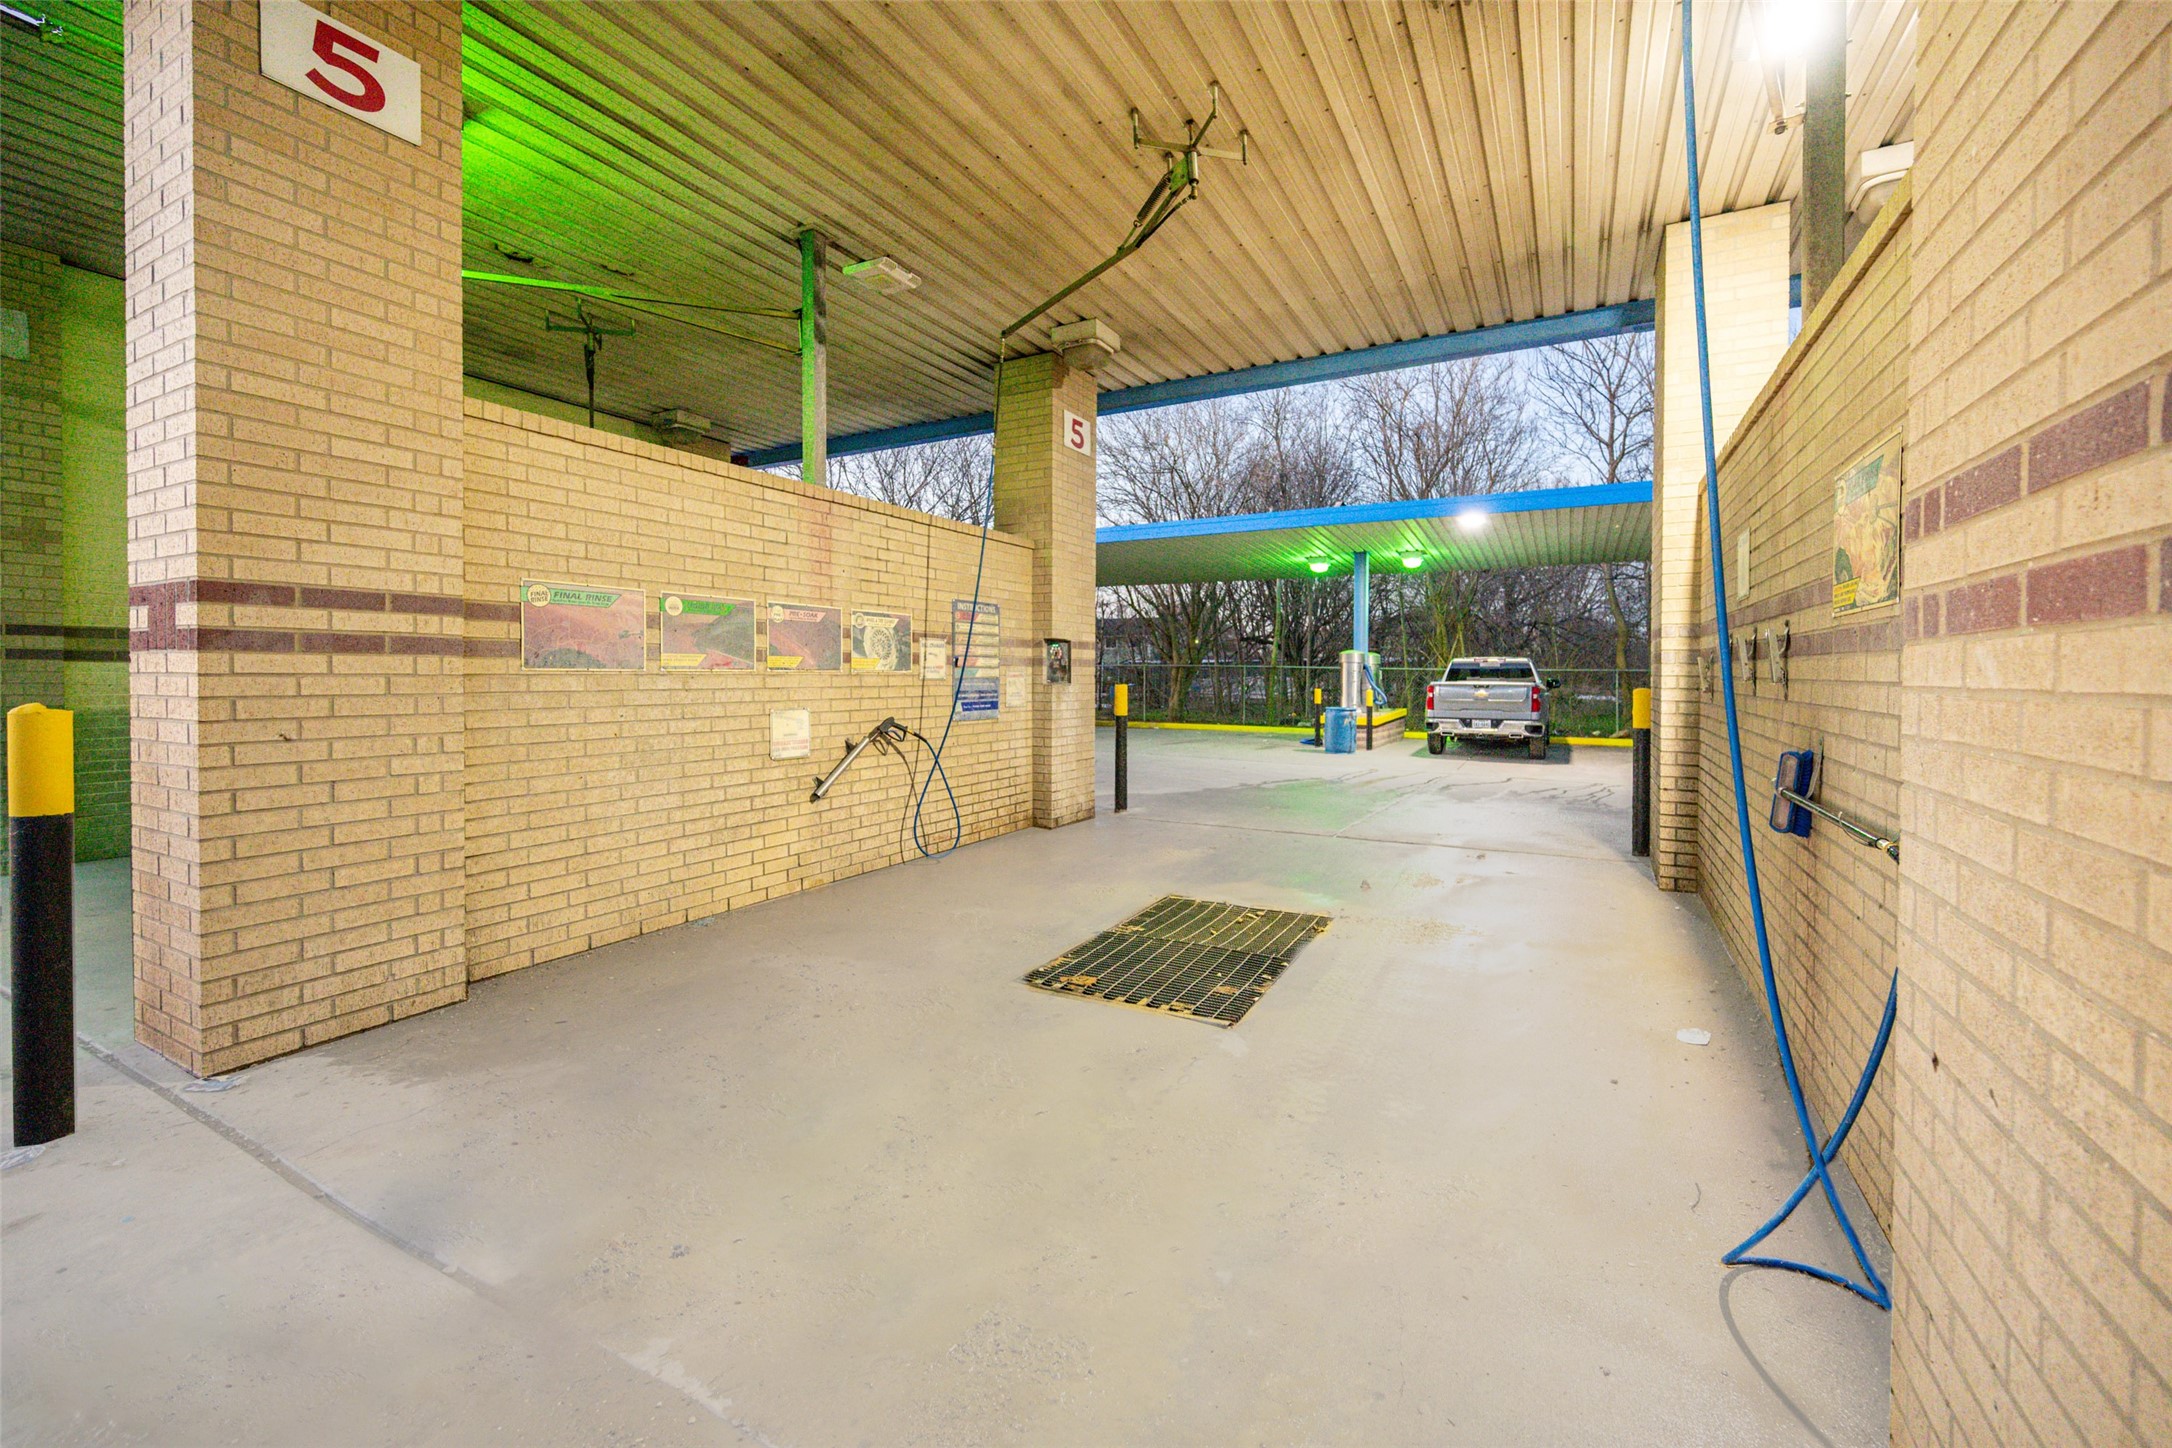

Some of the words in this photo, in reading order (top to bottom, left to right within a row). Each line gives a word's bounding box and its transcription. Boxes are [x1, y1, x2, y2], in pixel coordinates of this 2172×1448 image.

[305, 19, 386, 113] 5
[1071, 418, 1084, 449] 5
[553, 591, 582, 600] FINAL
[585, 594, 613, 603] RINSE
[957, 602, 996, 613] INSTRCTIONS
